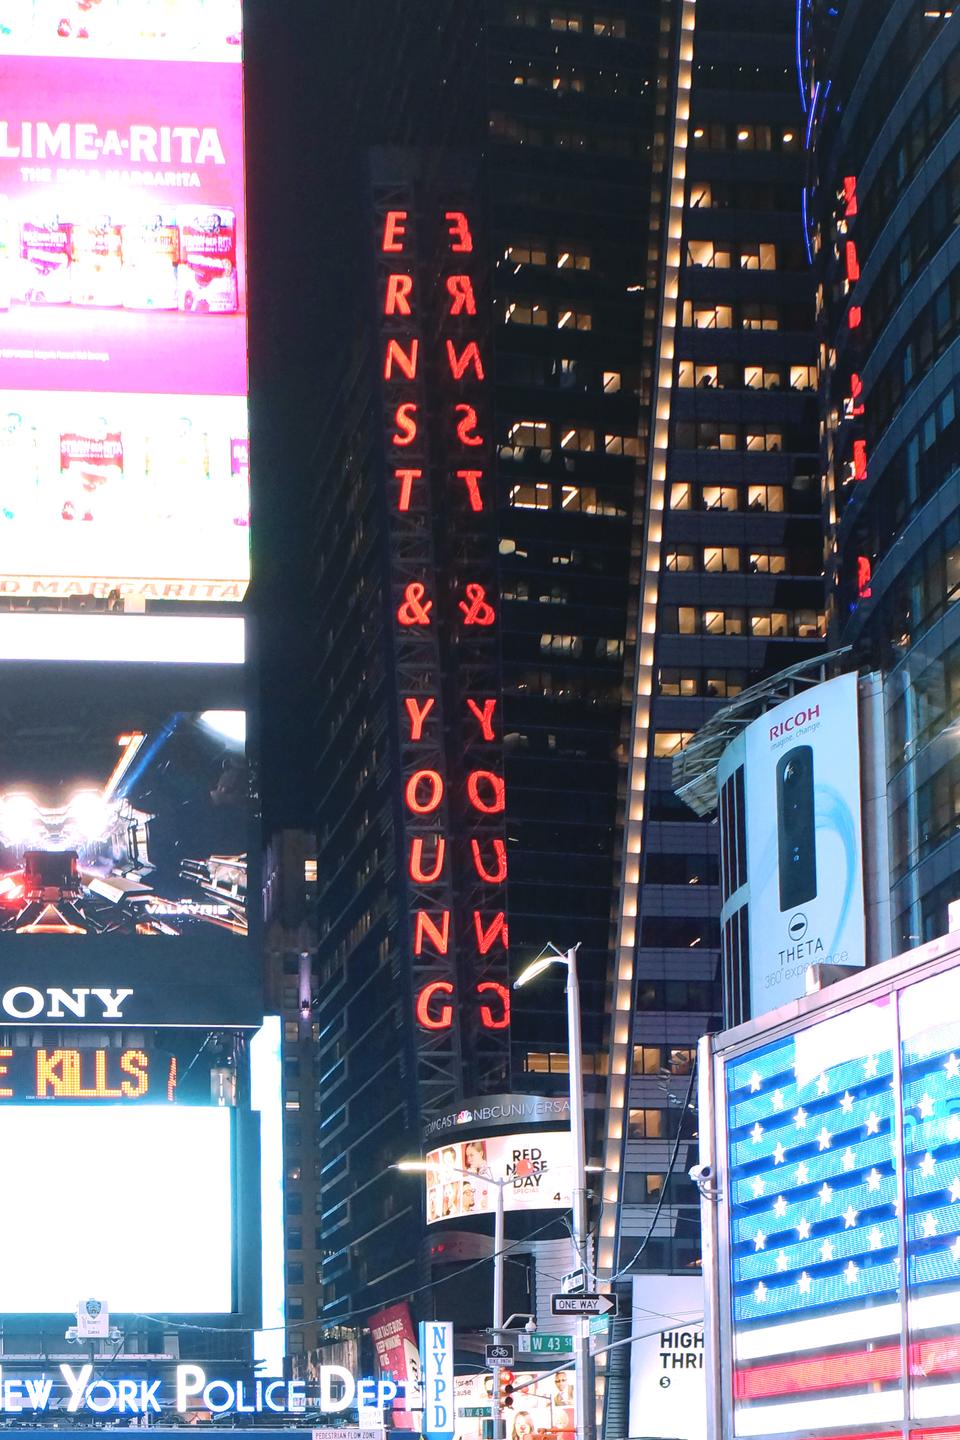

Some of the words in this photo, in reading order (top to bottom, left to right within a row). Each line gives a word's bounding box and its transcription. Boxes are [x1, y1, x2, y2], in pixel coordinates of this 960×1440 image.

[382, 211, 423, 513] ERNST
[33, 582, 242, 598] MARGARITA
[397, 583, 432, 625] &
[769, 704, 821, 741] RICOH
[405, 698, 453, 1029] YOUNG
[778, 938, 824, 966] THETA
[785, 951, 849, 980] expence
[36, 1050, 148, 1097] KILLS
[474, 1101, 570, 1121] NBCUNIVERSA
[513, 1148, 542, 1161] RED
[513, 1174, 542, 1188] DAY
[559, 1300, 577, 1309] ONE
[580, 1300, 598, 1309] WAY
[533, 1338, 542, 1350] W
[547, 1337, 560, 1350] 43
[432, 1326, 447, 1428] NYPD
